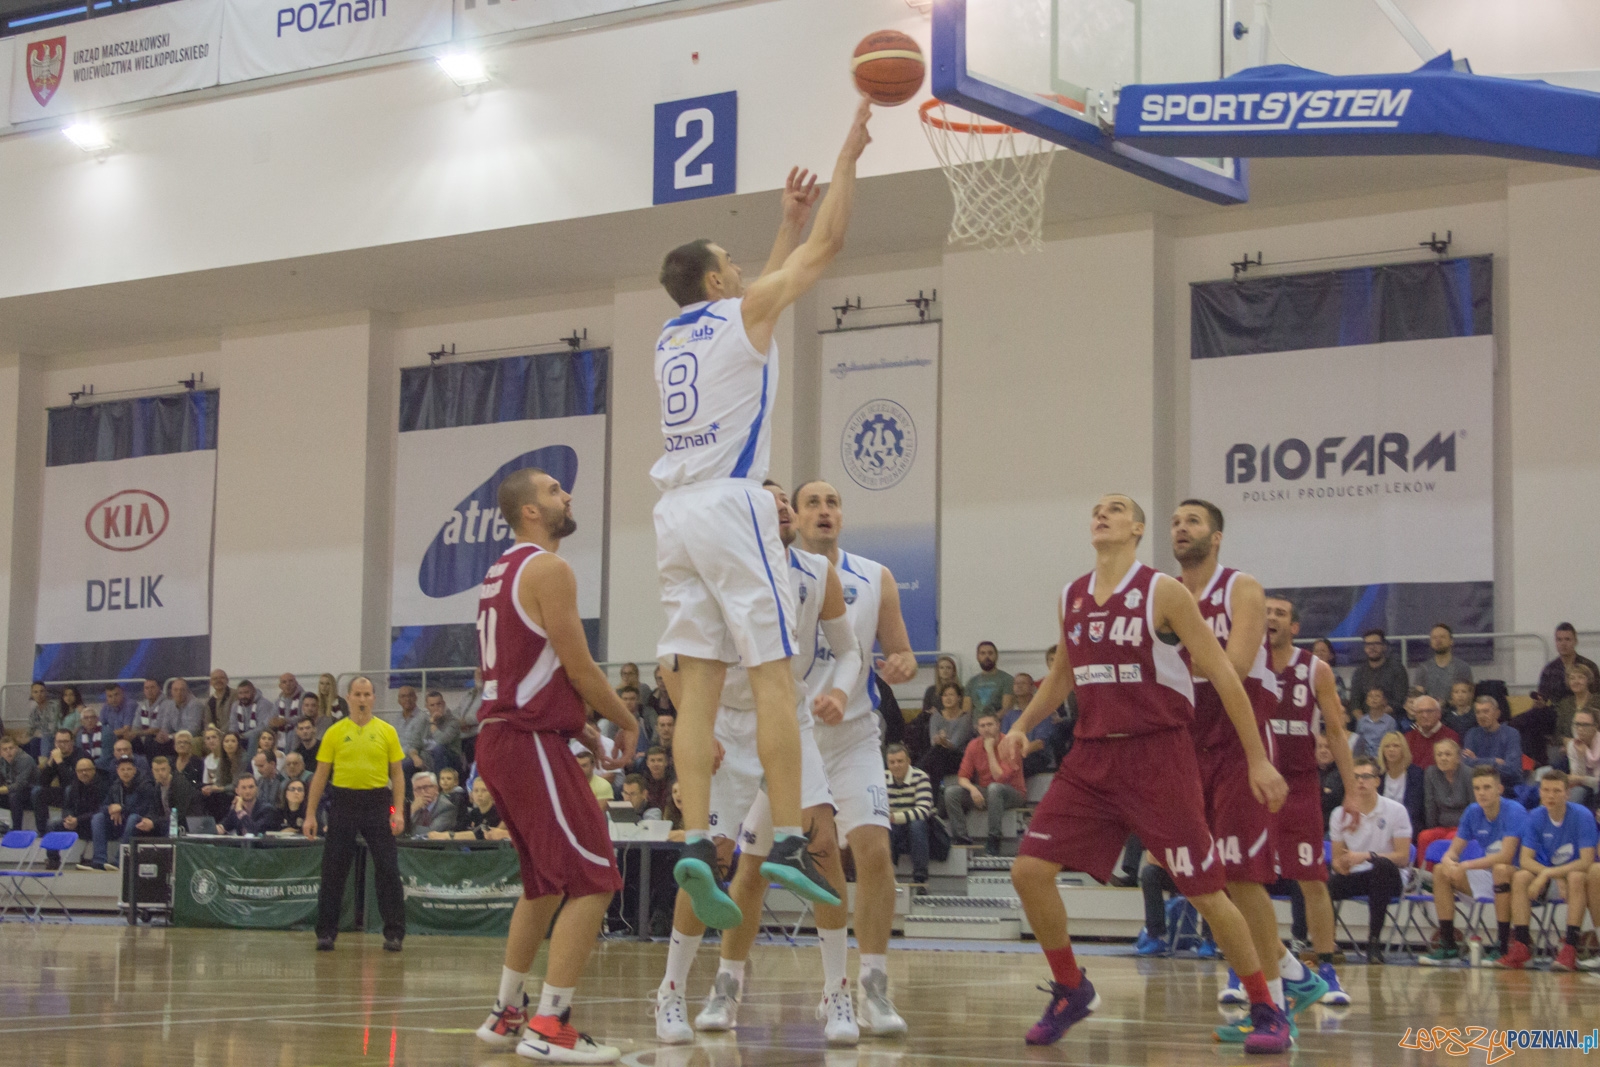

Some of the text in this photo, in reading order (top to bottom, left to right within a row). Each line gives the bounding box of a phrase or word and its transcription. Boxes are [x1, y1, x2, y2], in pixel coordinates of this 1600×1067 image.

[73, 33, 171, 64] URZĄD MARSZAŁKOWSKI
[73, 43, 210, 83] WOJEWÓDZTWA WIELKOPOLSKIEGO
[674, 107, 715, 190] 2
[662, 352, 699, 427] 8
[1225, 431, 1457, 485] BIOFARM
[1242, 490, 1291, 502] POLSKI
[1299, 484, 1380, 500] PRODUCENT
[103, 503, 154, 539] KIA
[86, 574, 164, 612] DELIK
[1109, 615, 1143, 647] 44
[1292, 683, 1308, 708] 9
[1298, 842, 1314, 867] 9
